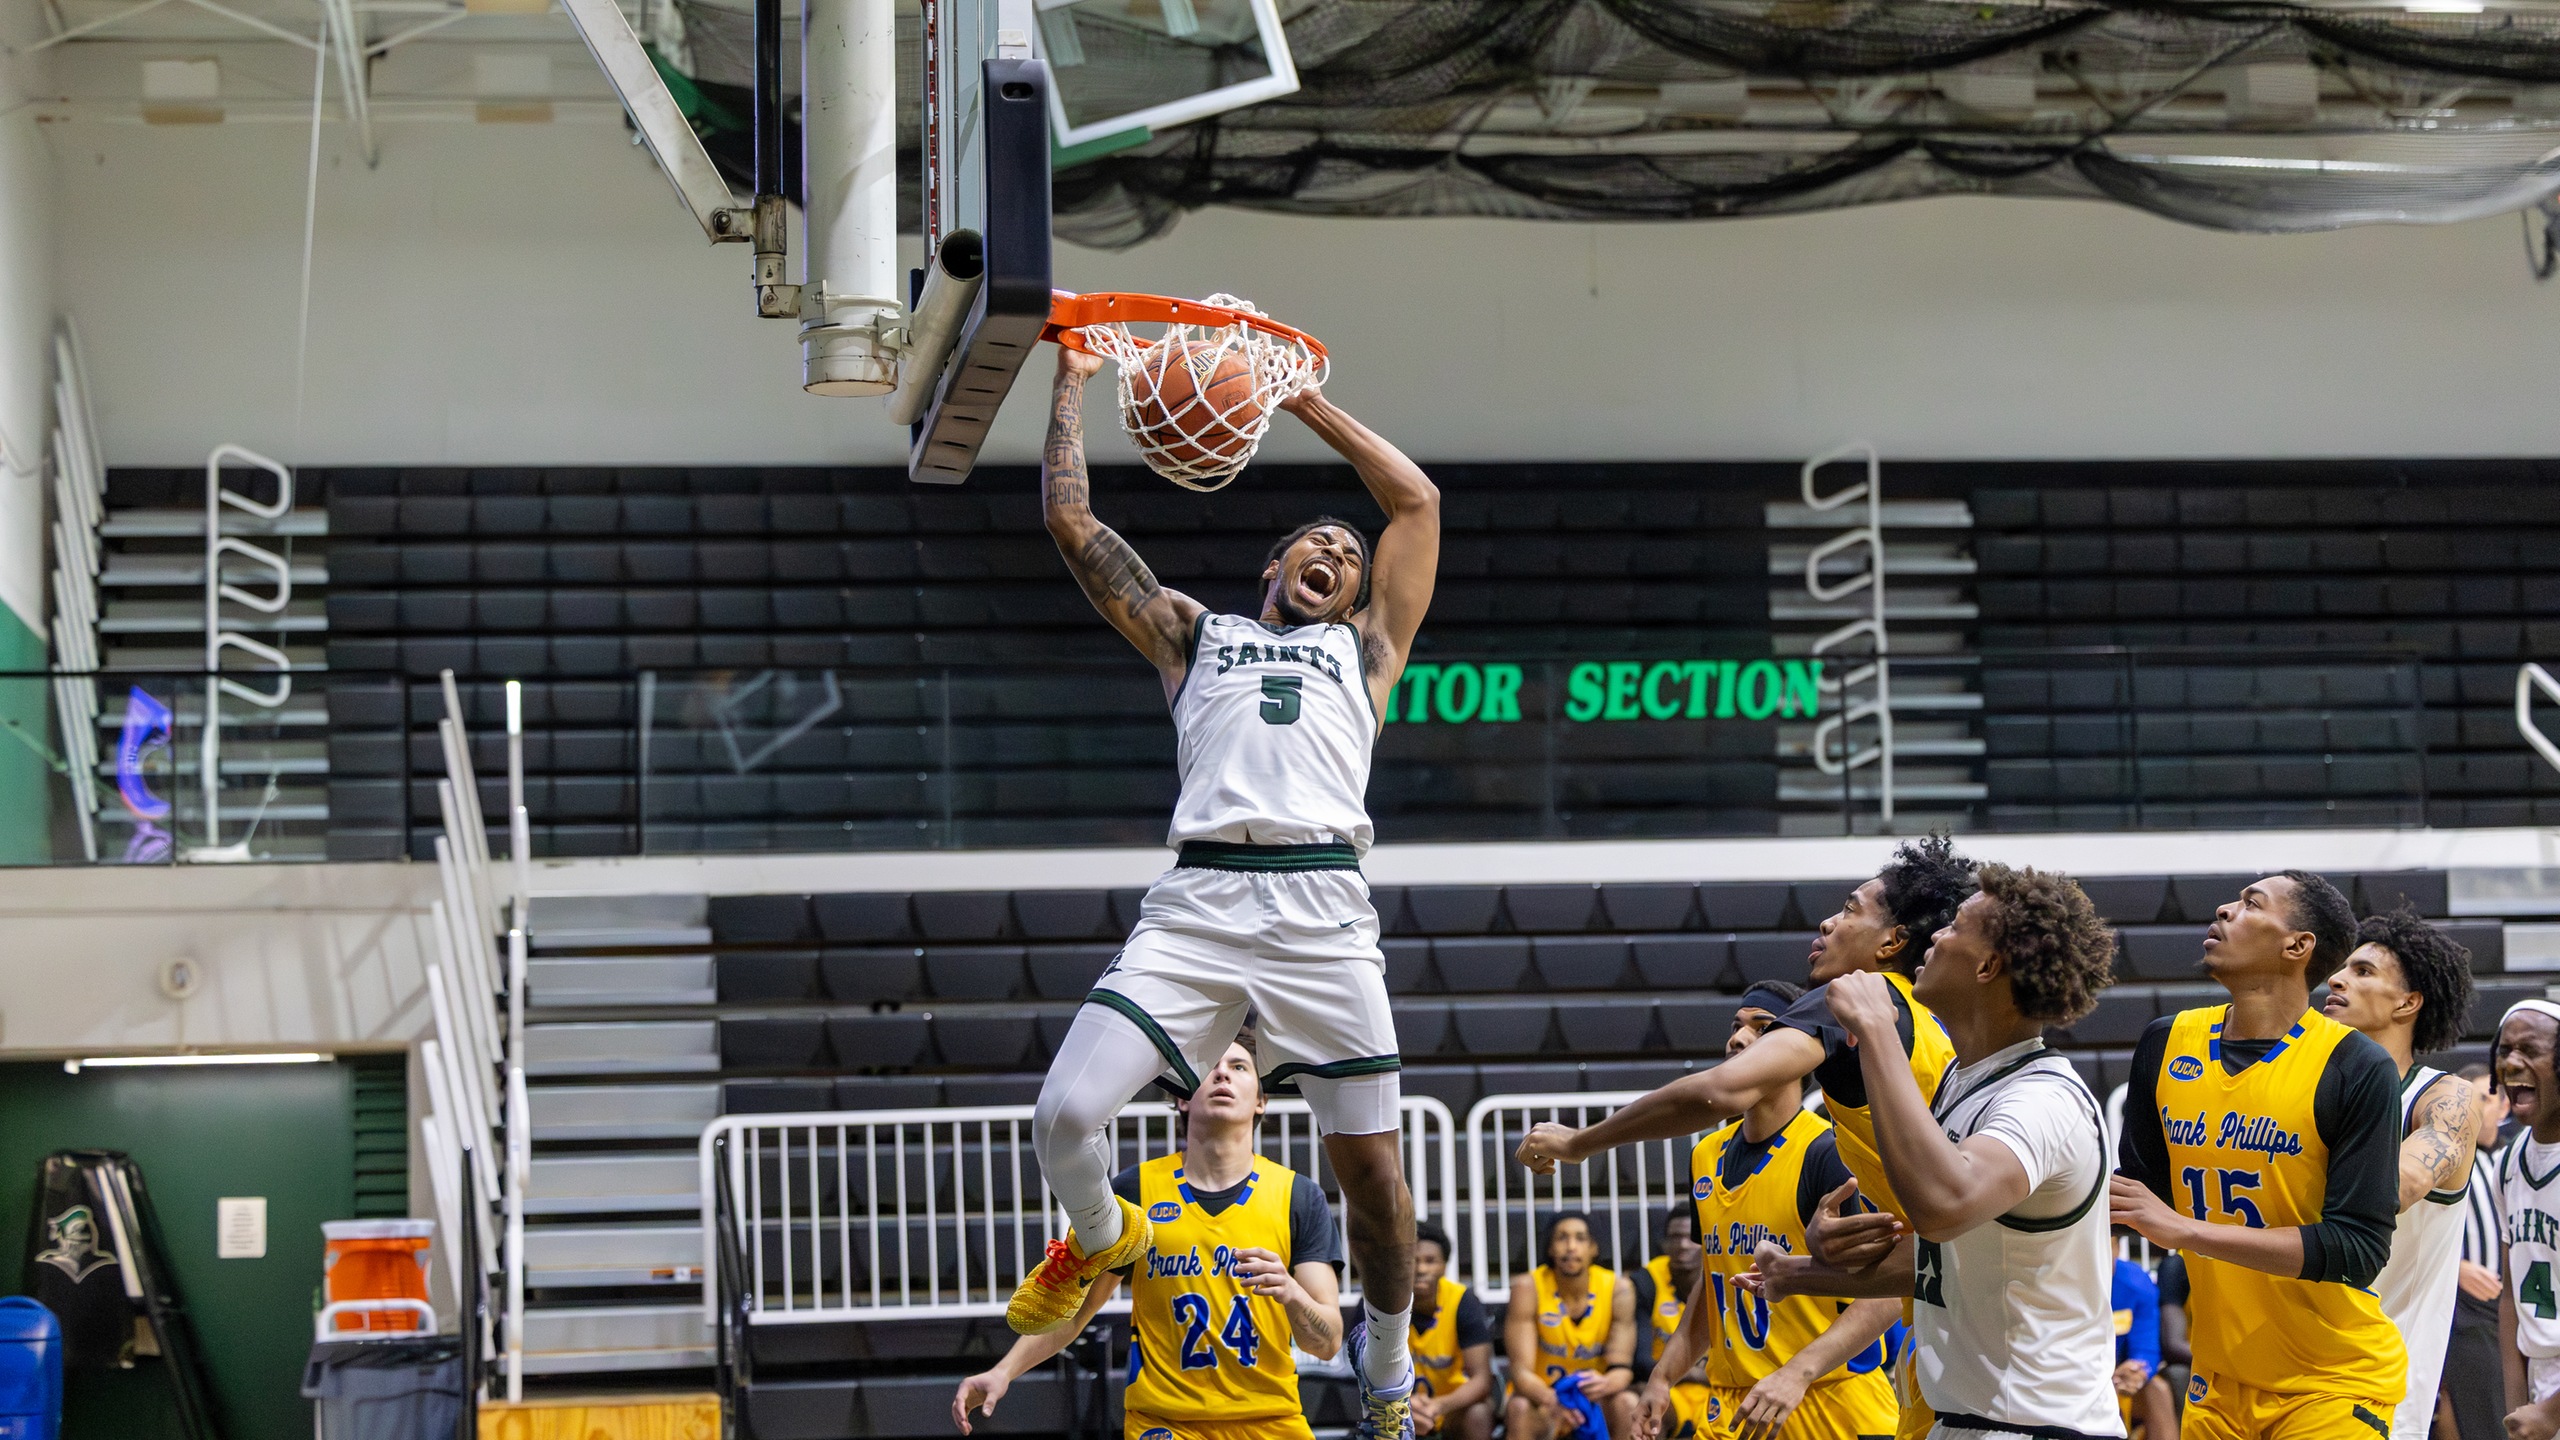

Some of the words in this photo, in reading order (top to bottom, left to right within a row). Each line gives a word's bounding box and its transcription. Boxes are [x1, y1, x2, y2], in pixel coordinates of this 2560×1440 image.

[1259, 675, 1303, 725] 5
[1564, 659, 1824, 723] SECTION
[2171, 1060, 2201, 1078] WJCAC
[2215, 1111, 2303, 1164] Phillips
[1150, 1206, 1180, 1218] WJCAC
[2181, 1166, 2271, 1229] 15
[1146, 1245, 1203, 1280] Frank
[2519, 1260, 2557, 1320] 4
[1172, 1292, 1260, 1372] 24
